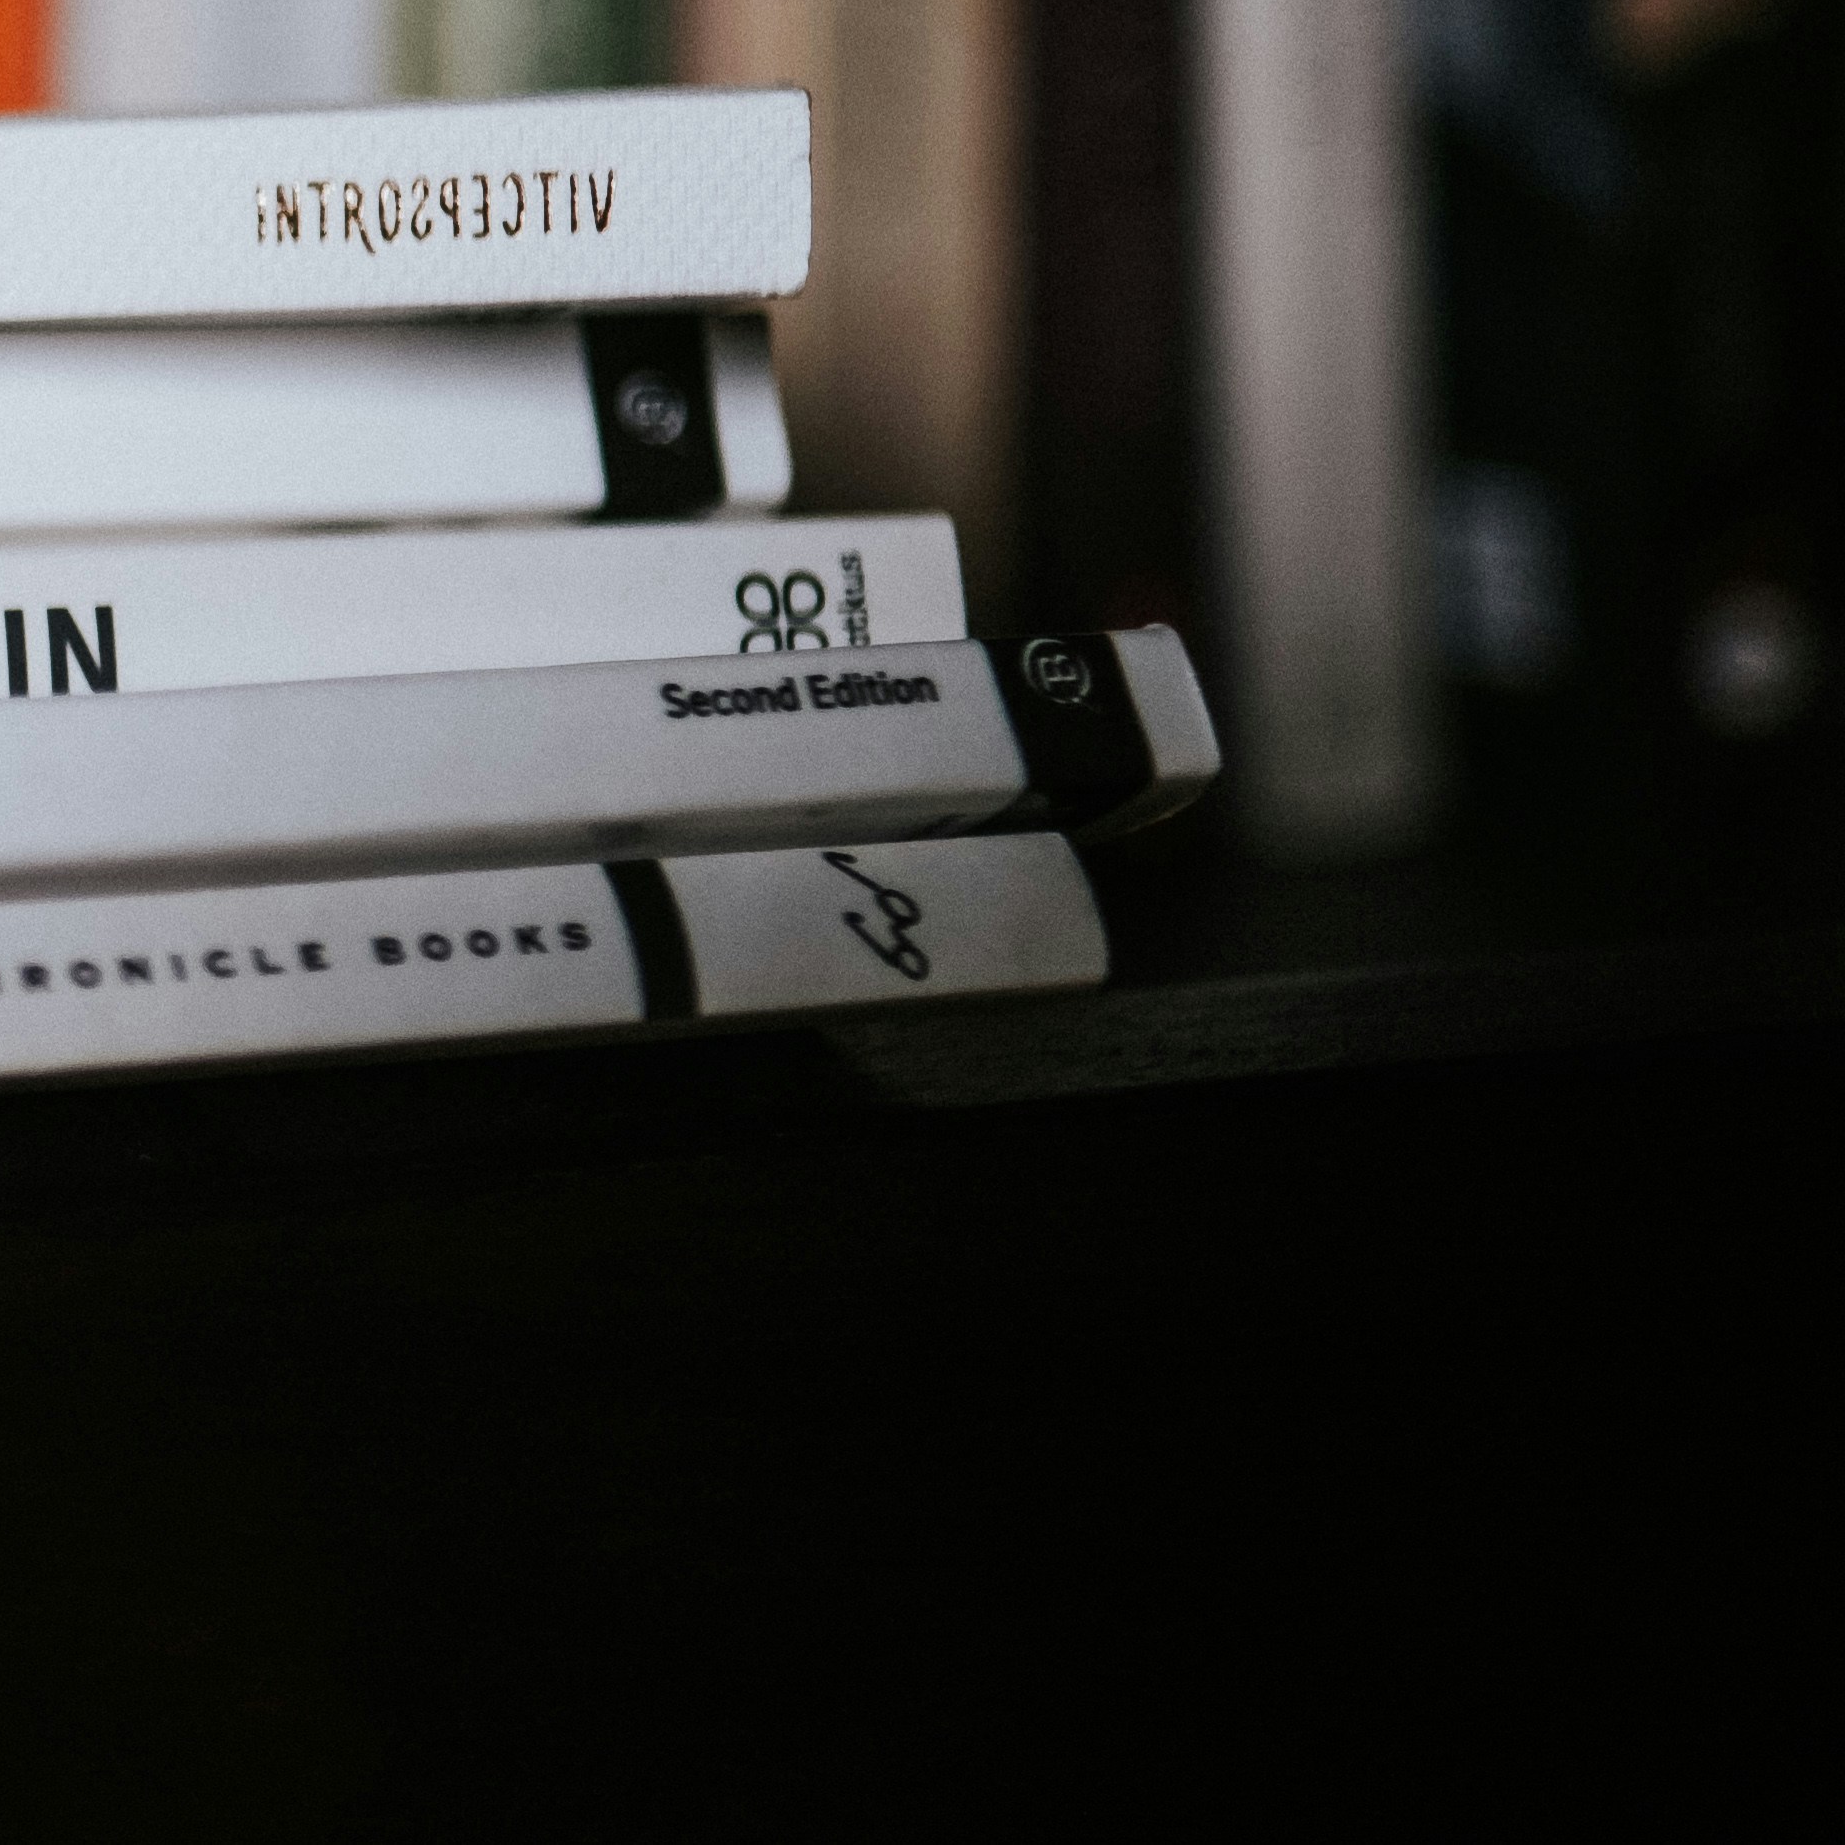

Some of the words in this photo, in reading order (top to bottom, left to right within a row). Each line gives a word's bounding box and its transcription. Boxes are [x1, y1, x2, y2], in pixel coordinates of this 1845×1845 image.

[660, 675, 802, 720] Second
[807, 670, 940, 711] Edition
[372, 921, 593, 966] BOOKS
